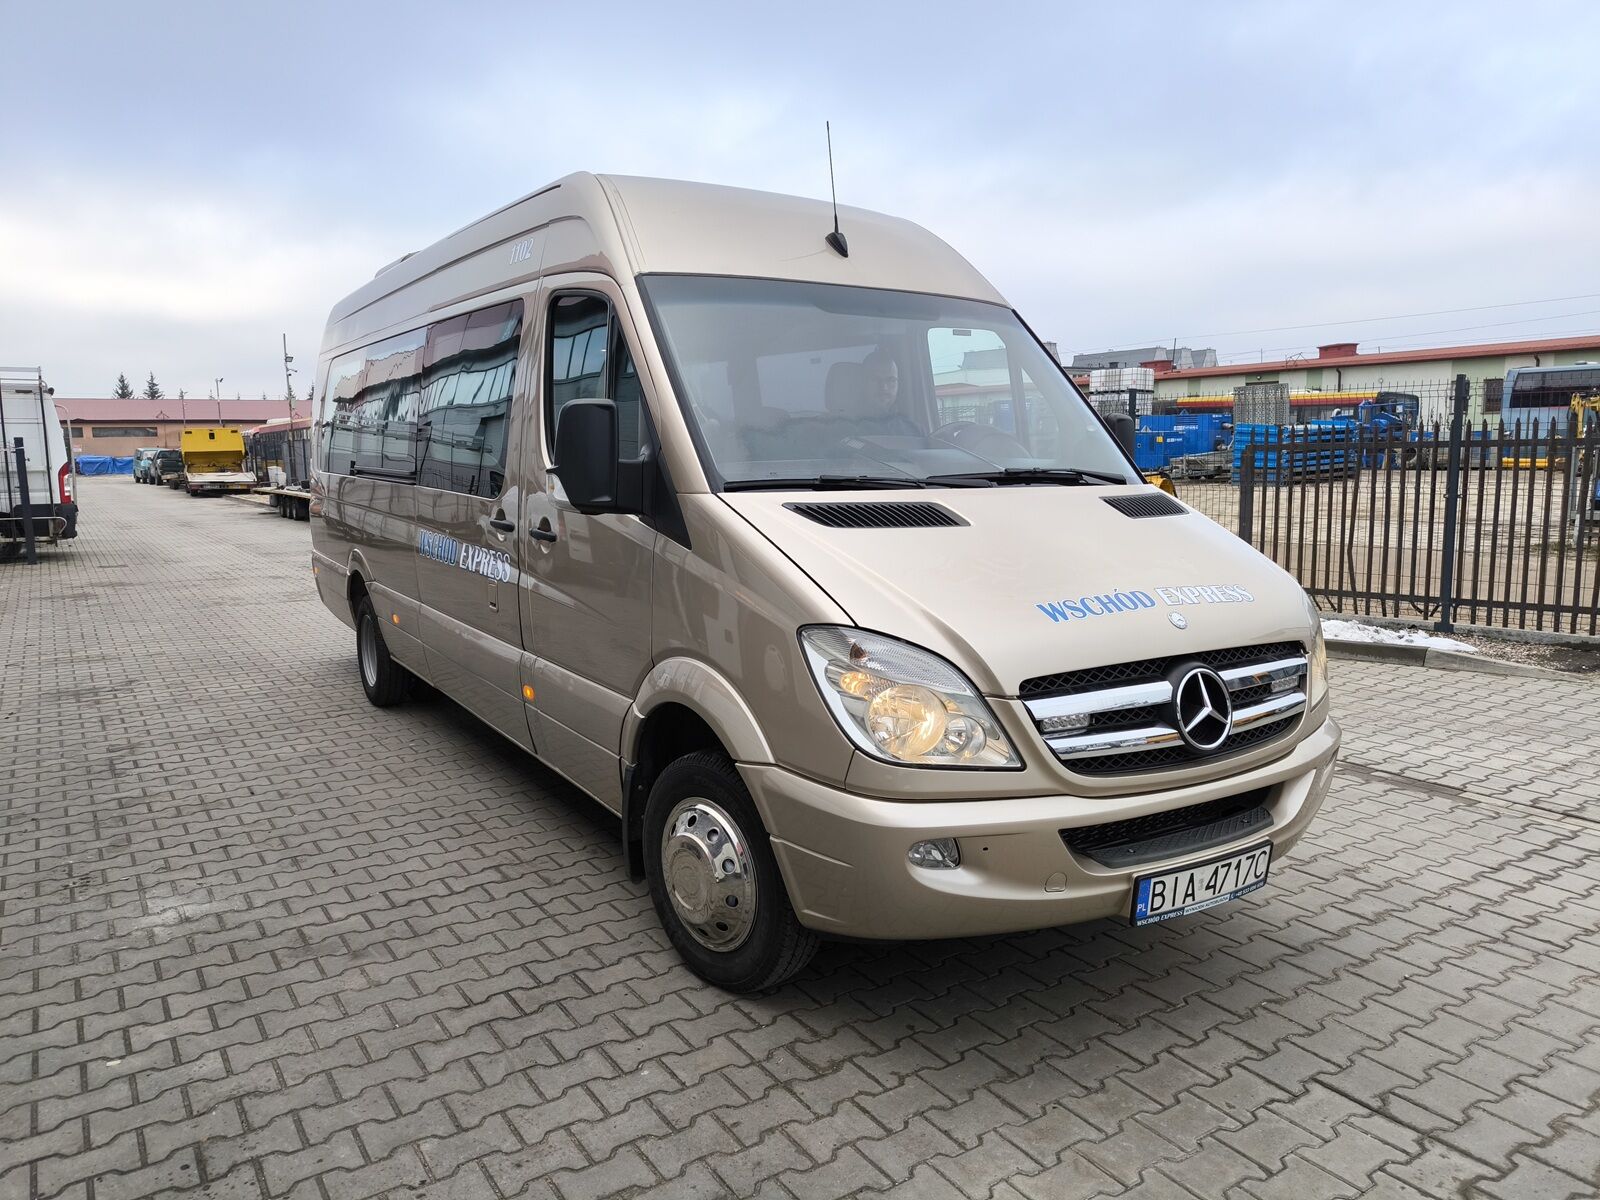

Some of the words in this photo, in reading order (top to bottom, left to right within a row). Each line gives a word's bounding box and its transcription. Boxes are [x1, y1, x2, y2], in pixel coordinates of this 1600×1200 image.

[509, 238, 534, 264] 1102
[459, 542, 511, 583] EXPRESS
[1036, 588, 1156, 623] WSCHÓD
[1154, 583, 1255, 607] EXPRESS
[1150, 873, 1196, 912] BIA
[1204, 850, 1268, 896] 4717C
[1136, 903, 1147, 913] PL
[1136, 915, 1160, 926] WSCHÓD
[1160, 909, 1184, 921] EXPRESS
